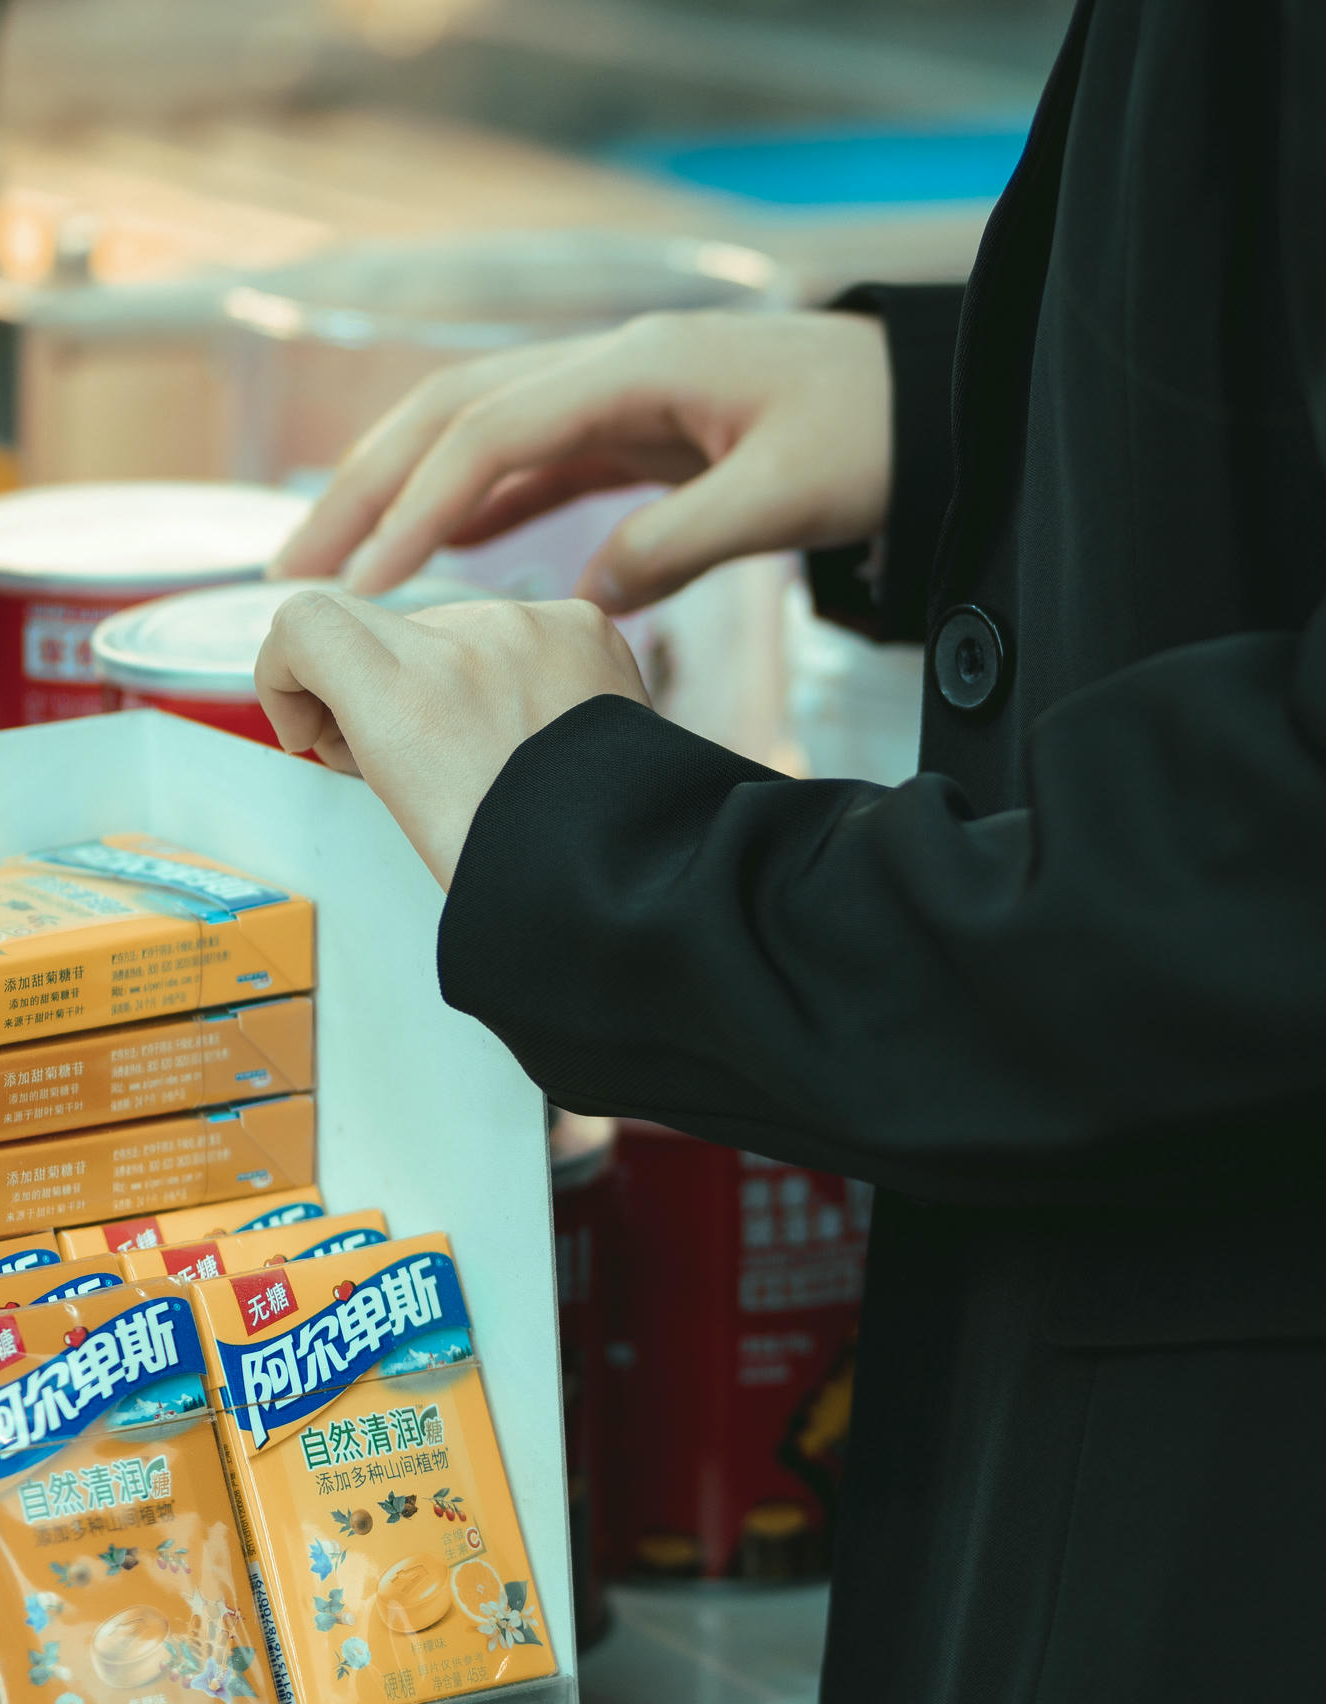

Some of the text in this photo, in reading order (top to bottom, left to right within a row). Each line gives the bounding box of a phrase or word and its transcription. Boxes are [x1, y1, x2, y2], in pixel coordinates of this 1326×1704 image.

[4, 966, 84, 992] 添加甜菊糖苷
[10, 988, 80, 1010] 添加的甜菊糖苷
[4, 1004, 84, 1029] 来源于甜叶菊干叶
[4, 1062, 84, 1088] 添加甜菊糖苷
[7, 1160, 86, 1186] 添加甜菊糖苷
[247, 1282, 290, 1327] 无糖
[241, 1257, 443, 1449] 阿尔卑斯
[256, 1579, 294, 1699] 911316 870079
[383, 1668, 417, 1701] 硬糖
[466, 1666, 490, 1684] 45克
